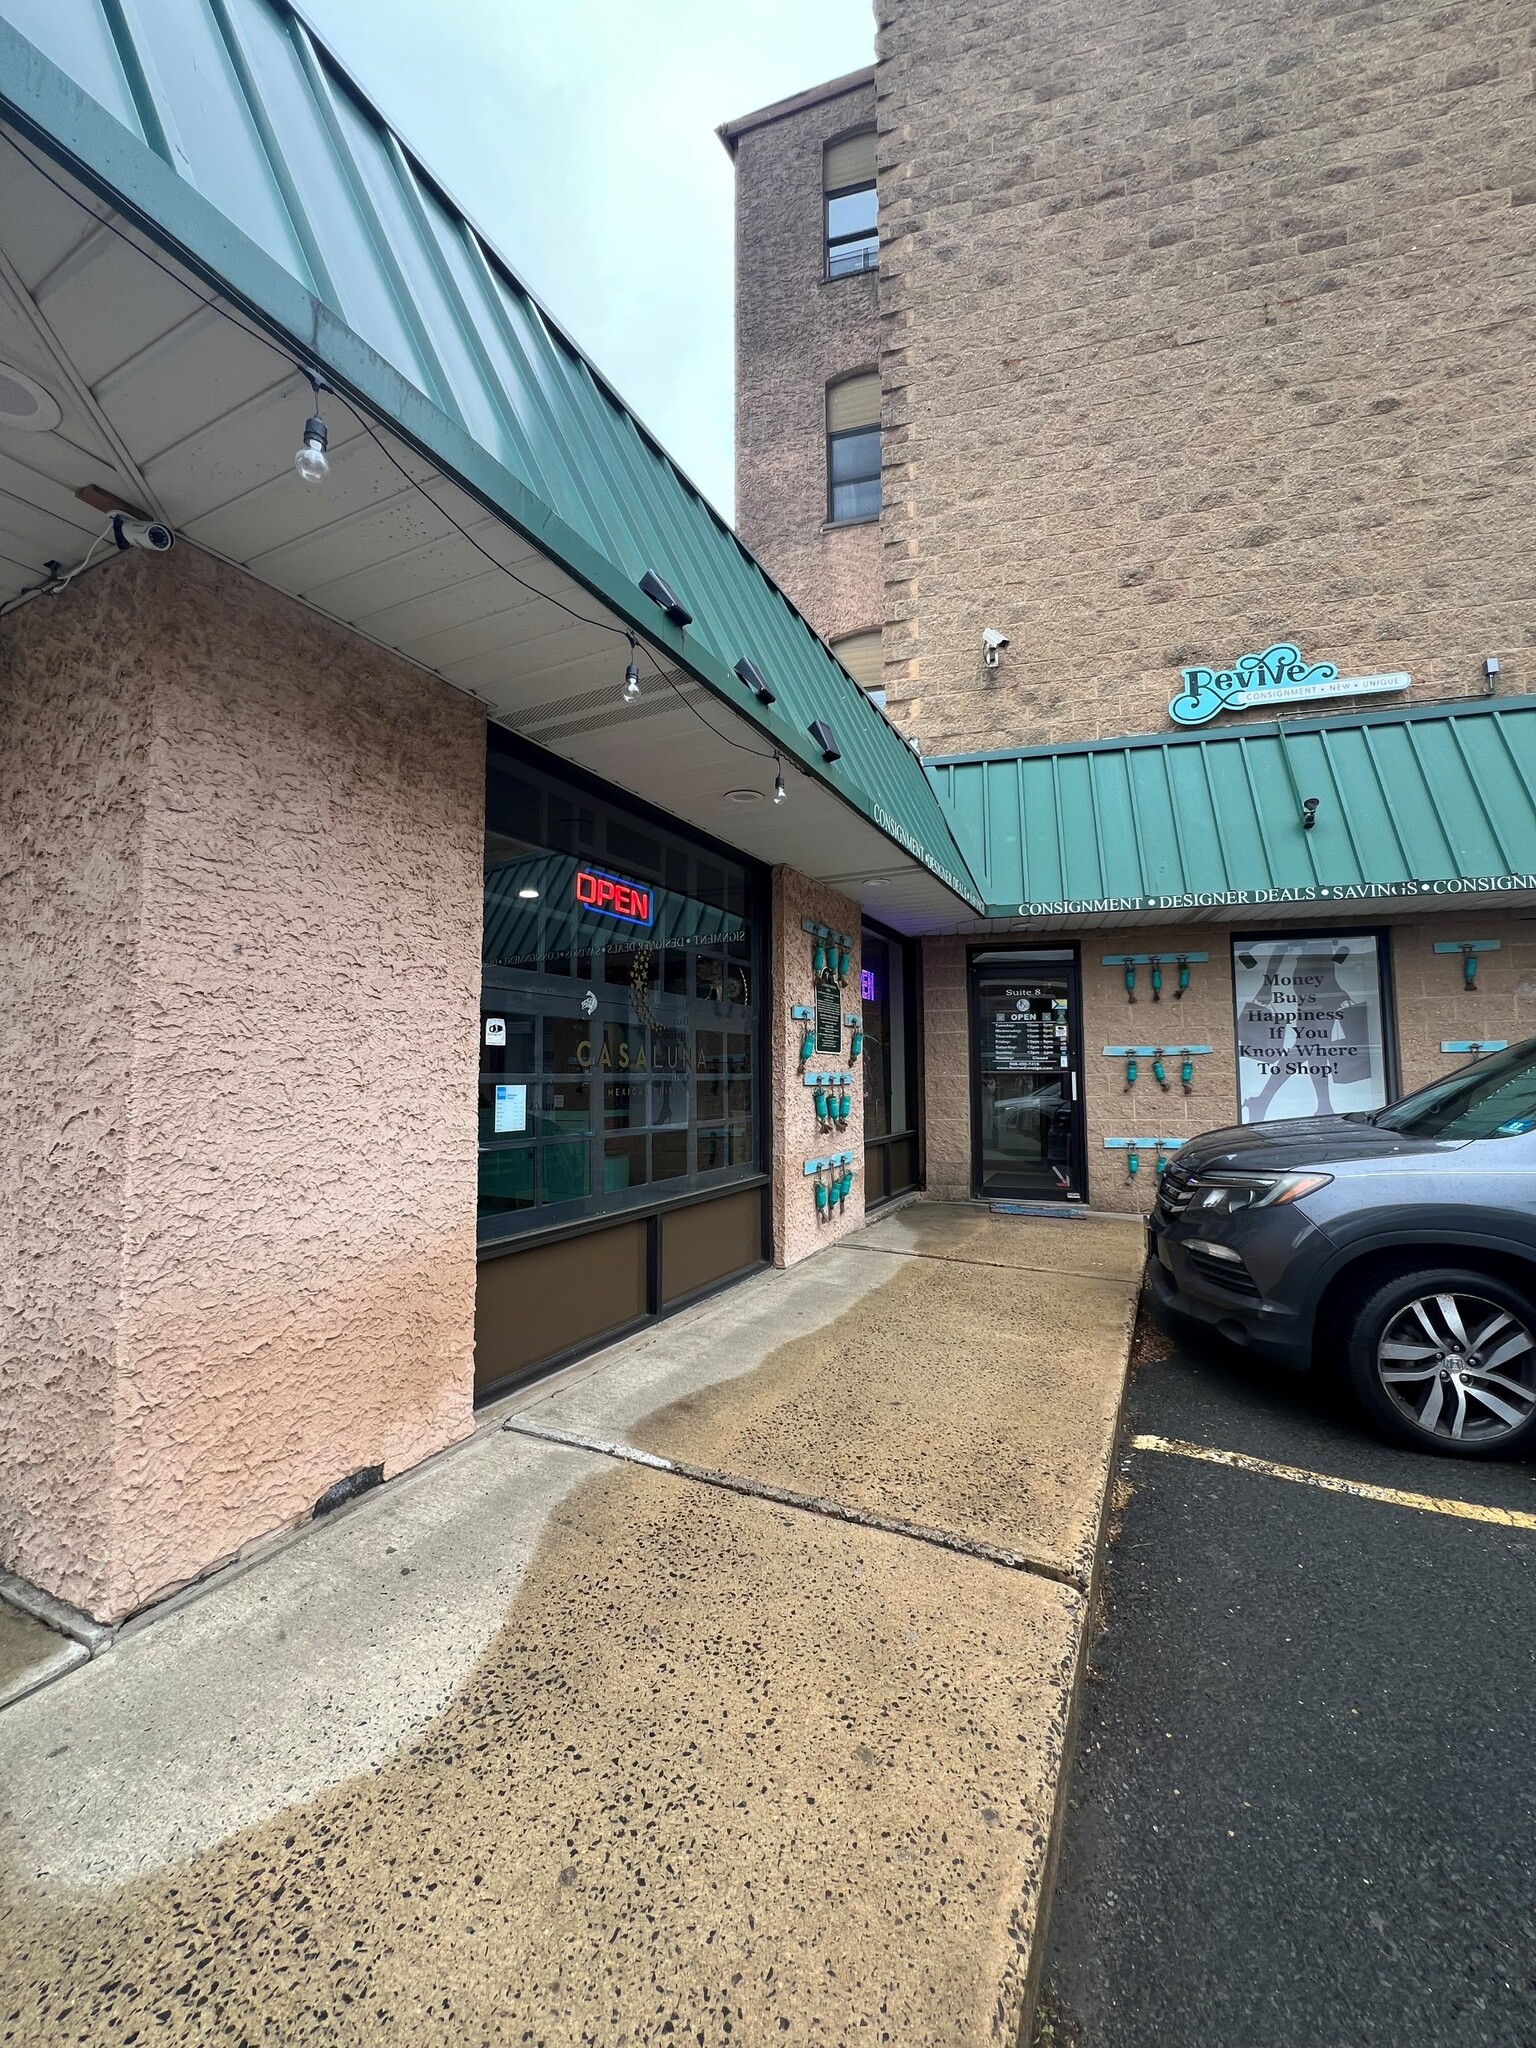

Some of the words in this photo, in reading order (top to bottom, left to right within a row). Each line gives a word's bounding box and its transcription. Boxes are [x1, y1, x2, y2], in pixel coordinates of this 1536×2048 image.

[1246, 686, 1317, 701] CONSIGNMENT
[1329, 682, 1352, 692] NEW
[1363, 677, 1399, 689] UNIQUE
[873, 804, 924, 861] CONSIGNMENT
[927, 854, 953, 887] DESIGNER
[577, 872, 648, 919] OPEN
[1018, 897, 1143, 916] CONSIGNMENT
[1159, 891, 1250, 909] DESIGNER
[1255, 887, 1316, 902] DEALS
[1263, 974, 1324, 987] Money
[1034, 988, 1041, 996] 8
[1273, 991, 1316, 1005] Buys
[1010, 1013, 1037, 1021] OPEN
[1248, 1008, 1344, 1024] Happiness
[1269, 1027, 1285, 1039] If
[1291, 1026, 1328, 1039] You
[1239, 1045, 1289, 1057] Know
[1295, 1044, 1358, 1056] Where
[1257, 1063, 1280, 1075] To
[1285, 1062, 1338, 1077] Shop!
